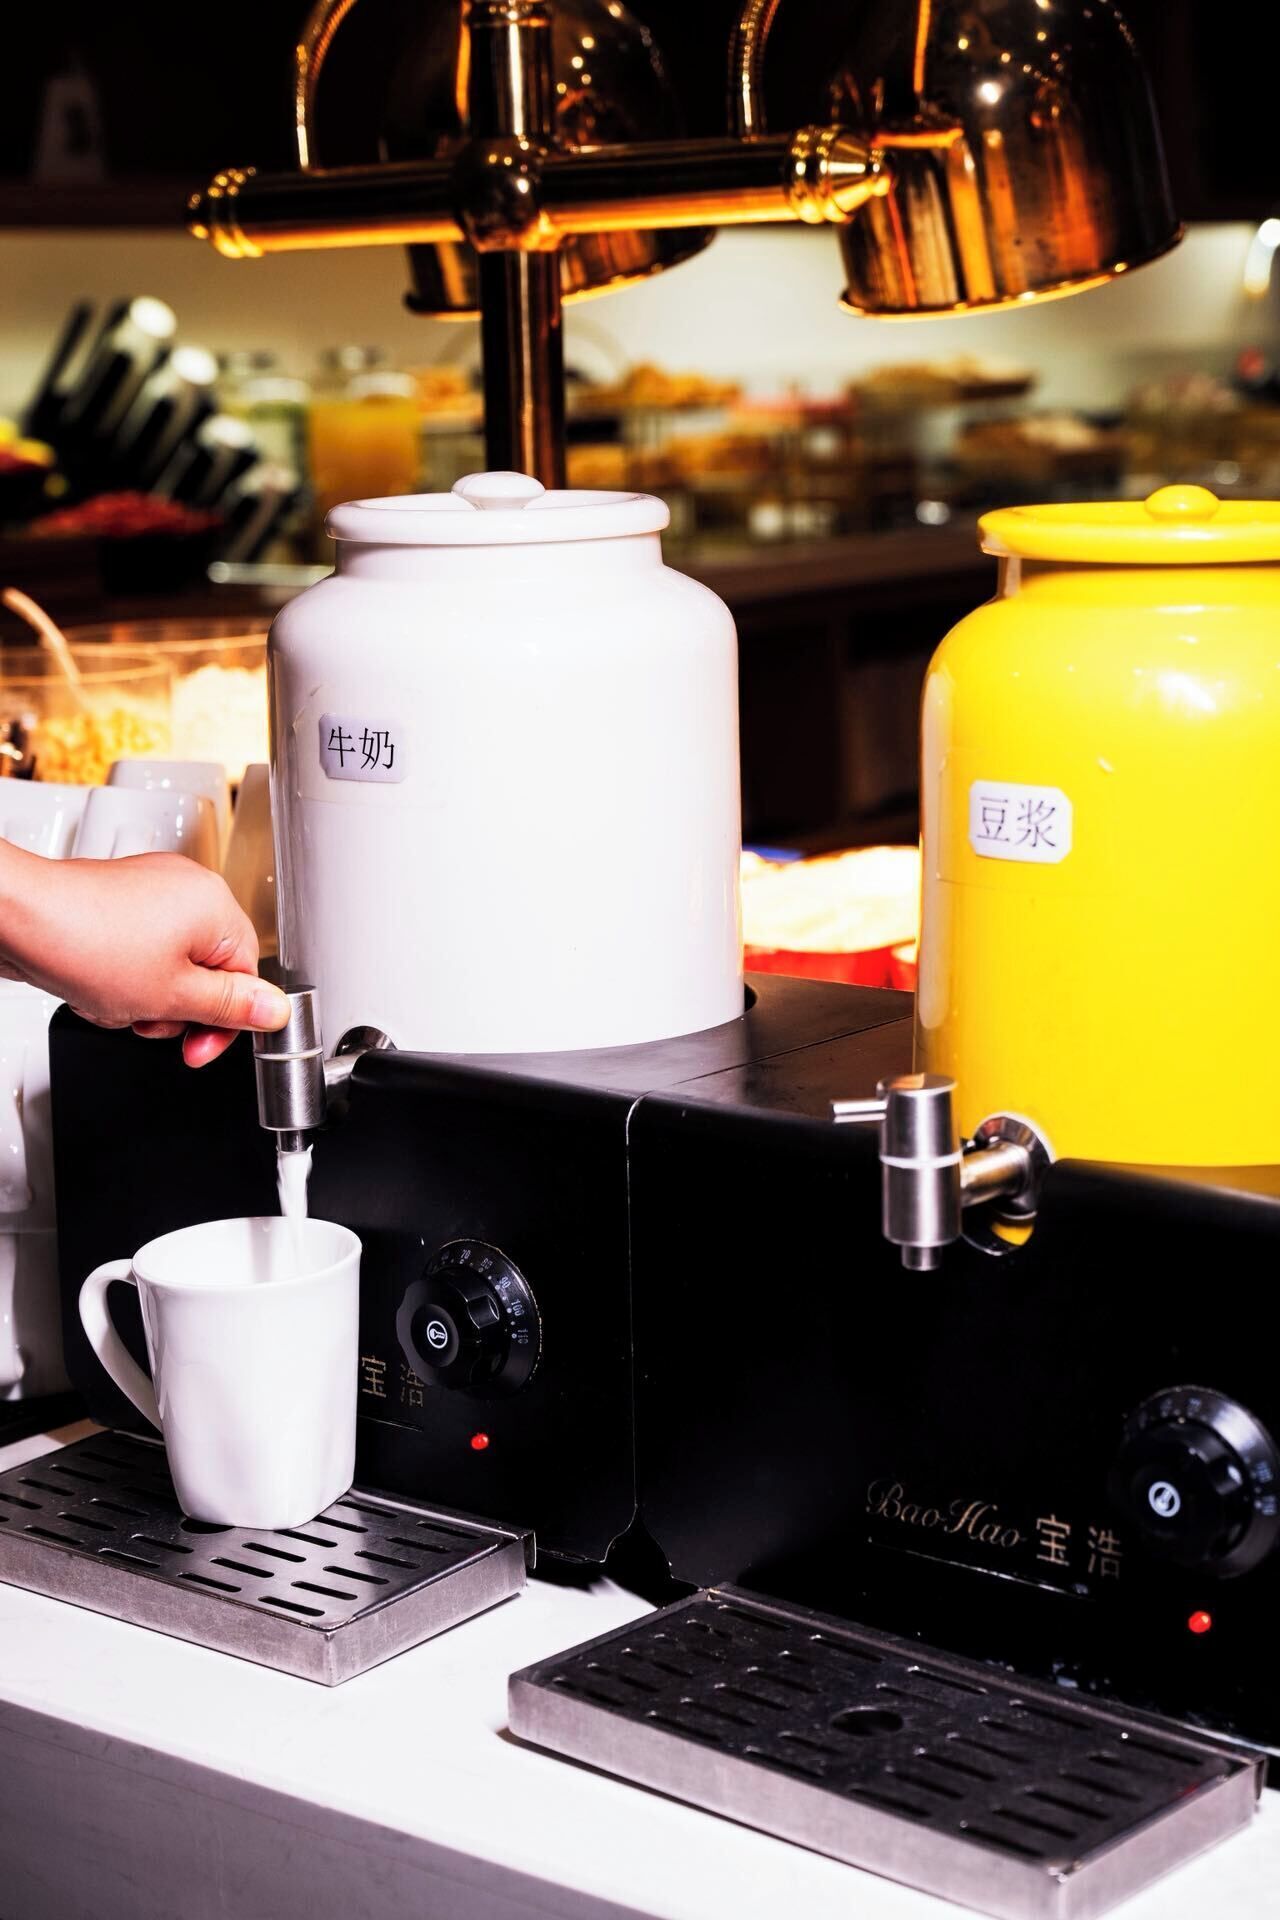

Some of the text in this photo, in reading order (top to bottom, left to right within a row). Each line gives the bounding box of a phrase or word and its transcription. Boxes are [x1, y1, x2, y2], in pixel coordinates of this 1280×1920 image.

[327, 726, 395, 769] 牛奶
[976, 797, 1056, 847] 豆浆
[1035, 1513, 1124, 1581] 宝浩
